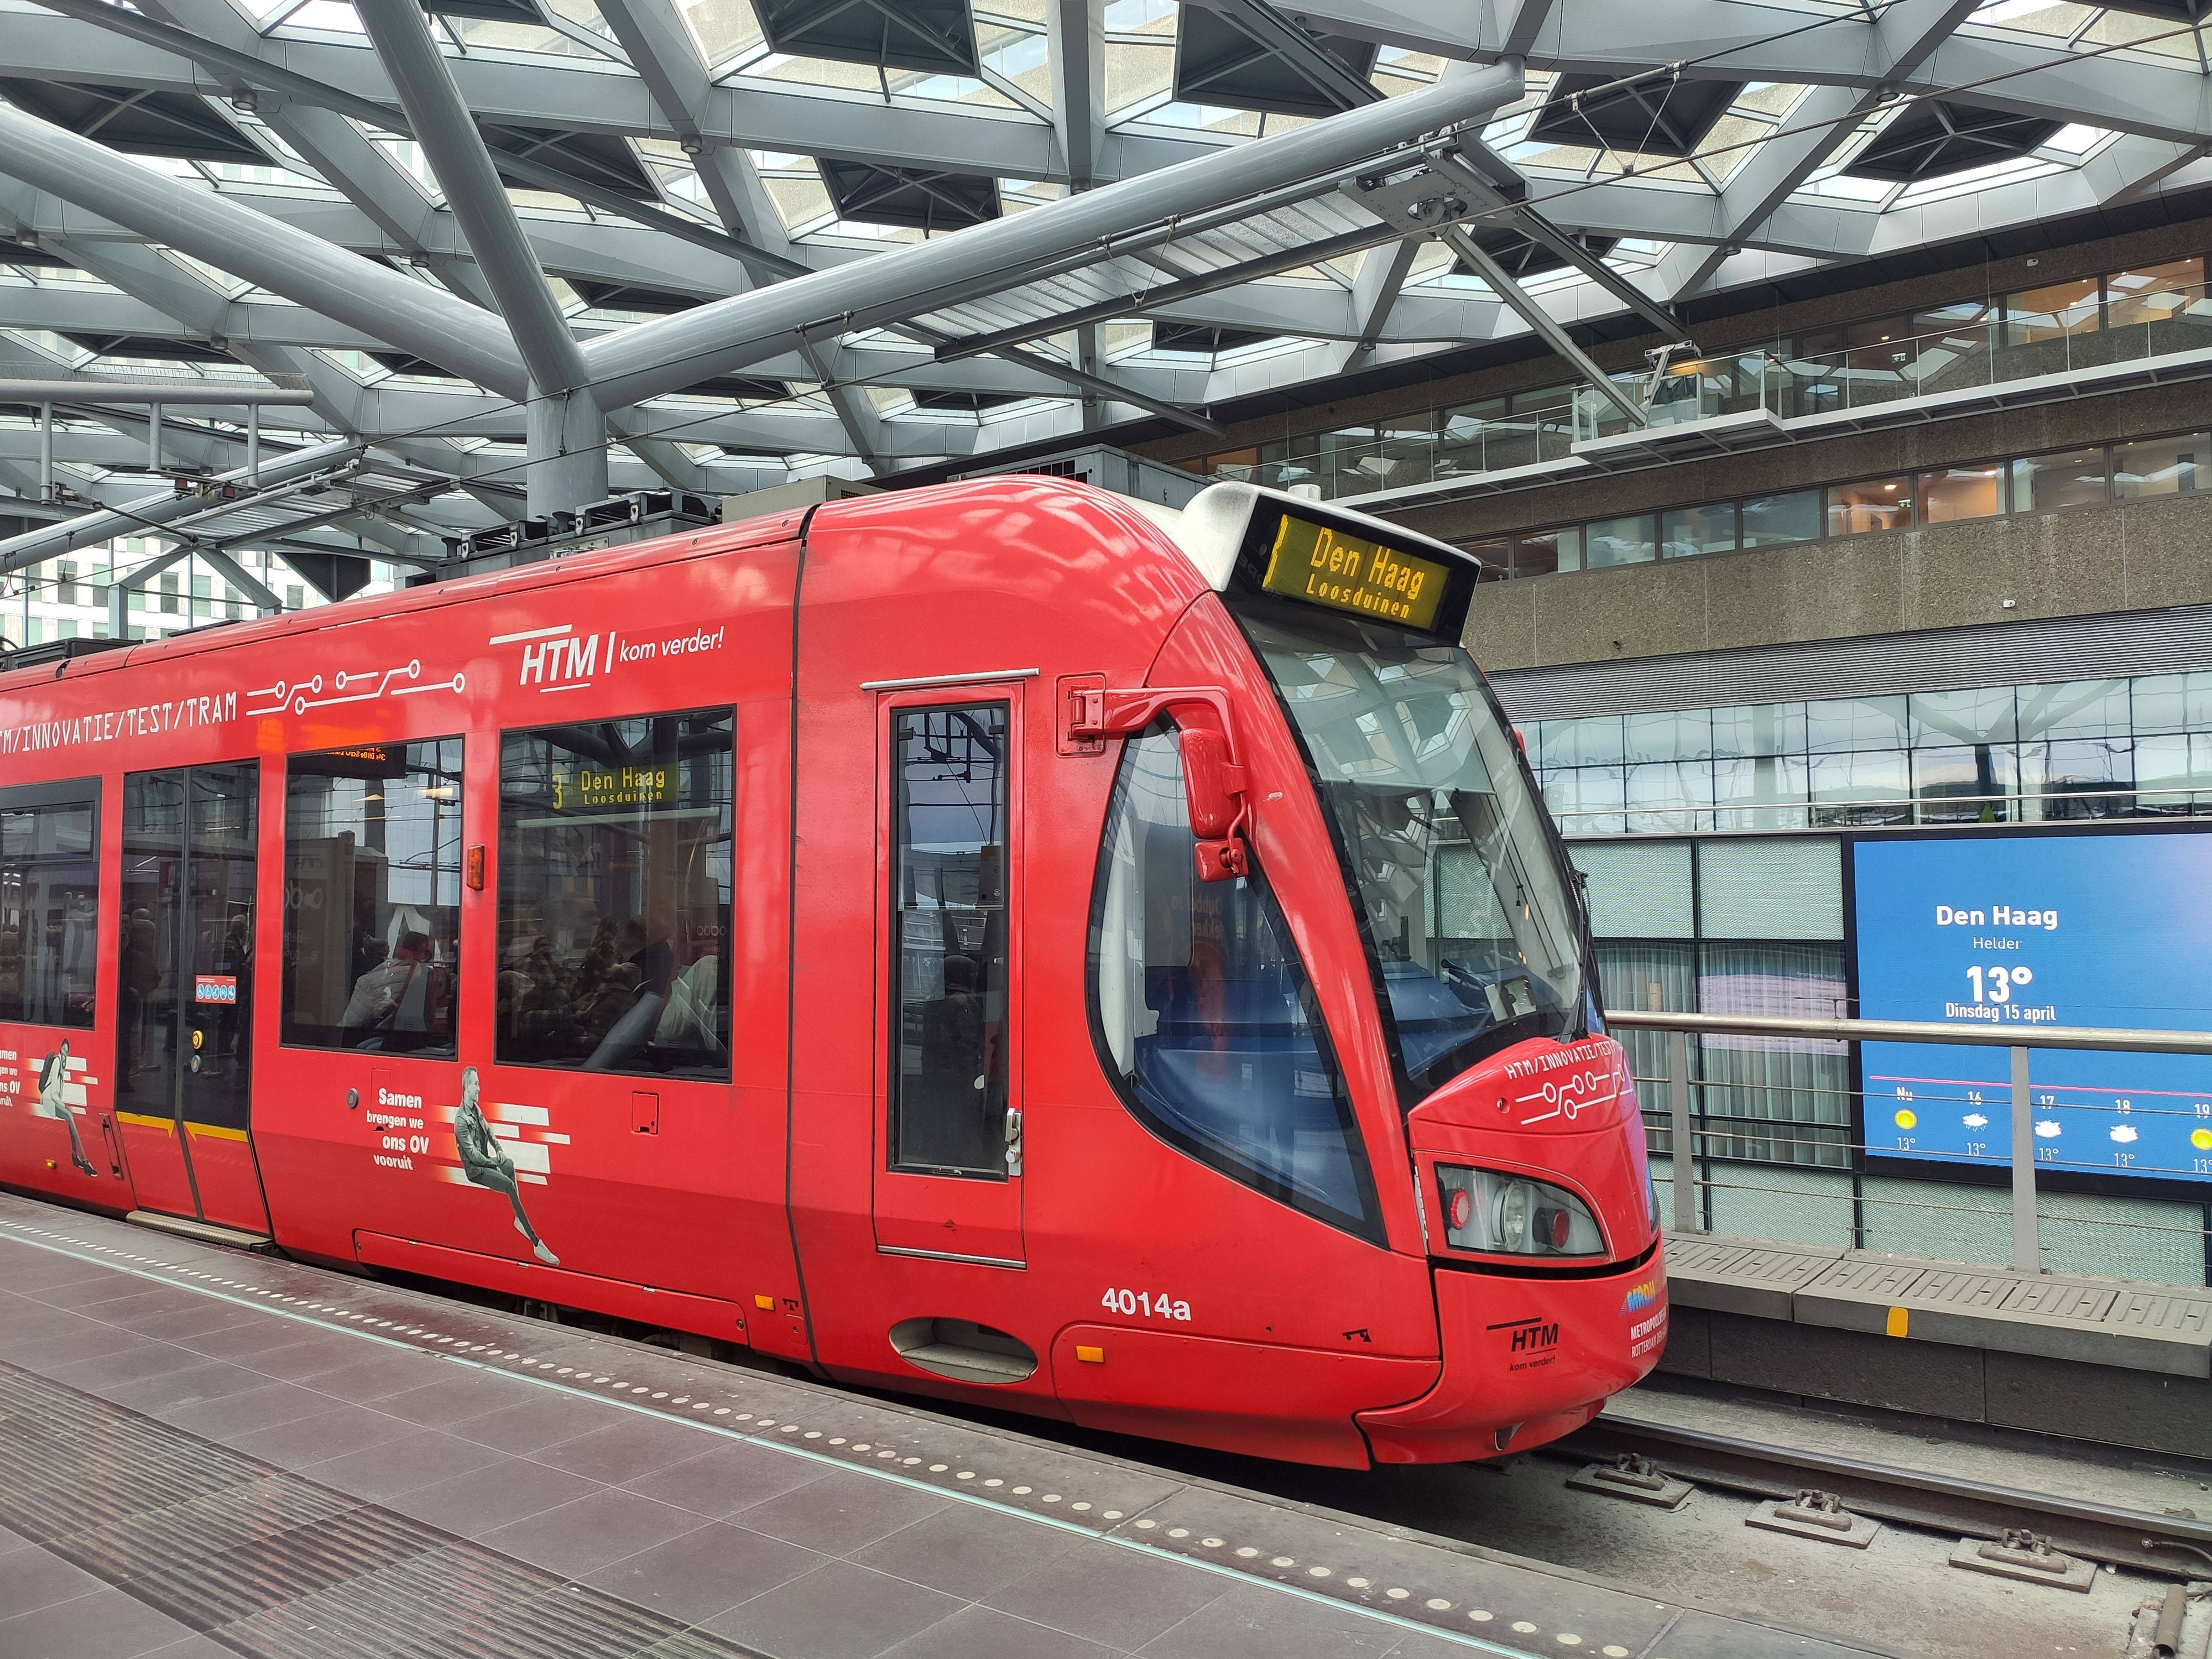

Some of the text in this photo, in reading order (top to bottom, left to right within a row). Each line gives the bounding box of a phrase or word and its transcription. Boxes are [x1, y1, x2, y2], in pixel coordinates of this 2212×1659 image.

[1311, 527, 1359, 577] Den
[1368, 545, 1425, 599] Haag
[1306, 573, 1410, 619] Loosduinen
[520, 626, 724, 685] HTM kom verder!
[552, 766, 665, 810] 3 Den Haag
[584, 790, 662, 805] Loosduinen
[1937, 905, 2058, 930] Den Haag
[1973, 937, 2022, 950] Helder
[1966, 965, 2033, 1003] 13°
[1945, 1002, 2057, 1024] Dinsdag 15 april
[9, 1067, 18, 1076] we
[9, 1080, 20, 1094] OV
[378, 1088, 422, 1109] Samen
[1897, 1087, 2210, 1119] Nu 16 17 18 19
[367, 1109, 424, 1129] brengen we
[382, 1135, 429, 1155] ons OV
[373, 1154, 414, 1171] vooruit
[1102, 1288, 1192, 1321] 4014a
[1511, 1323, 1559, 1352] HTM
[1631, 1334, 1657, 1358] ROTTERDAM
[1510, 1355, 1556, 1372] kom verder!
